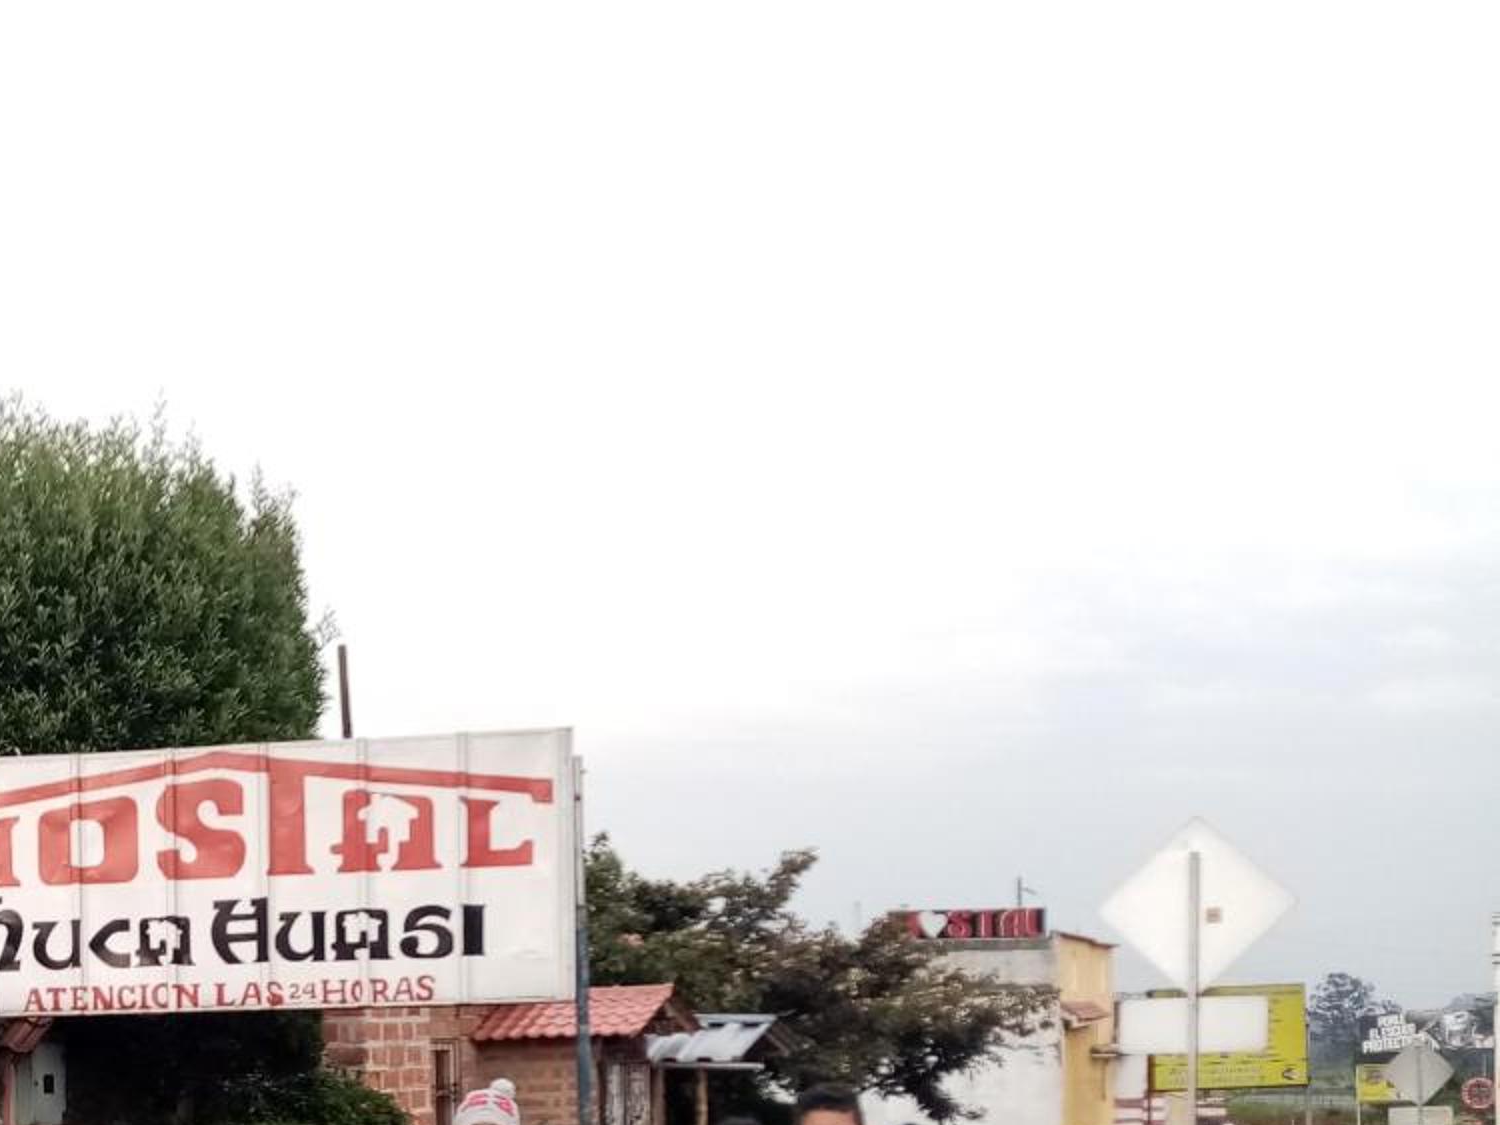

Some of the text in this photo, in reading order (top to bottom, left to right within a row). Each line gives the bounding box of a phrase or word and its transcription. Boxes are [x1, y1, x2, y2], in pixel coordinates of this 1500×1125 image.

[215, 980, 286, 1009] LAS
[289, 981, 317, 1001] 24
[320, 975, 437, 1006] HORAS
